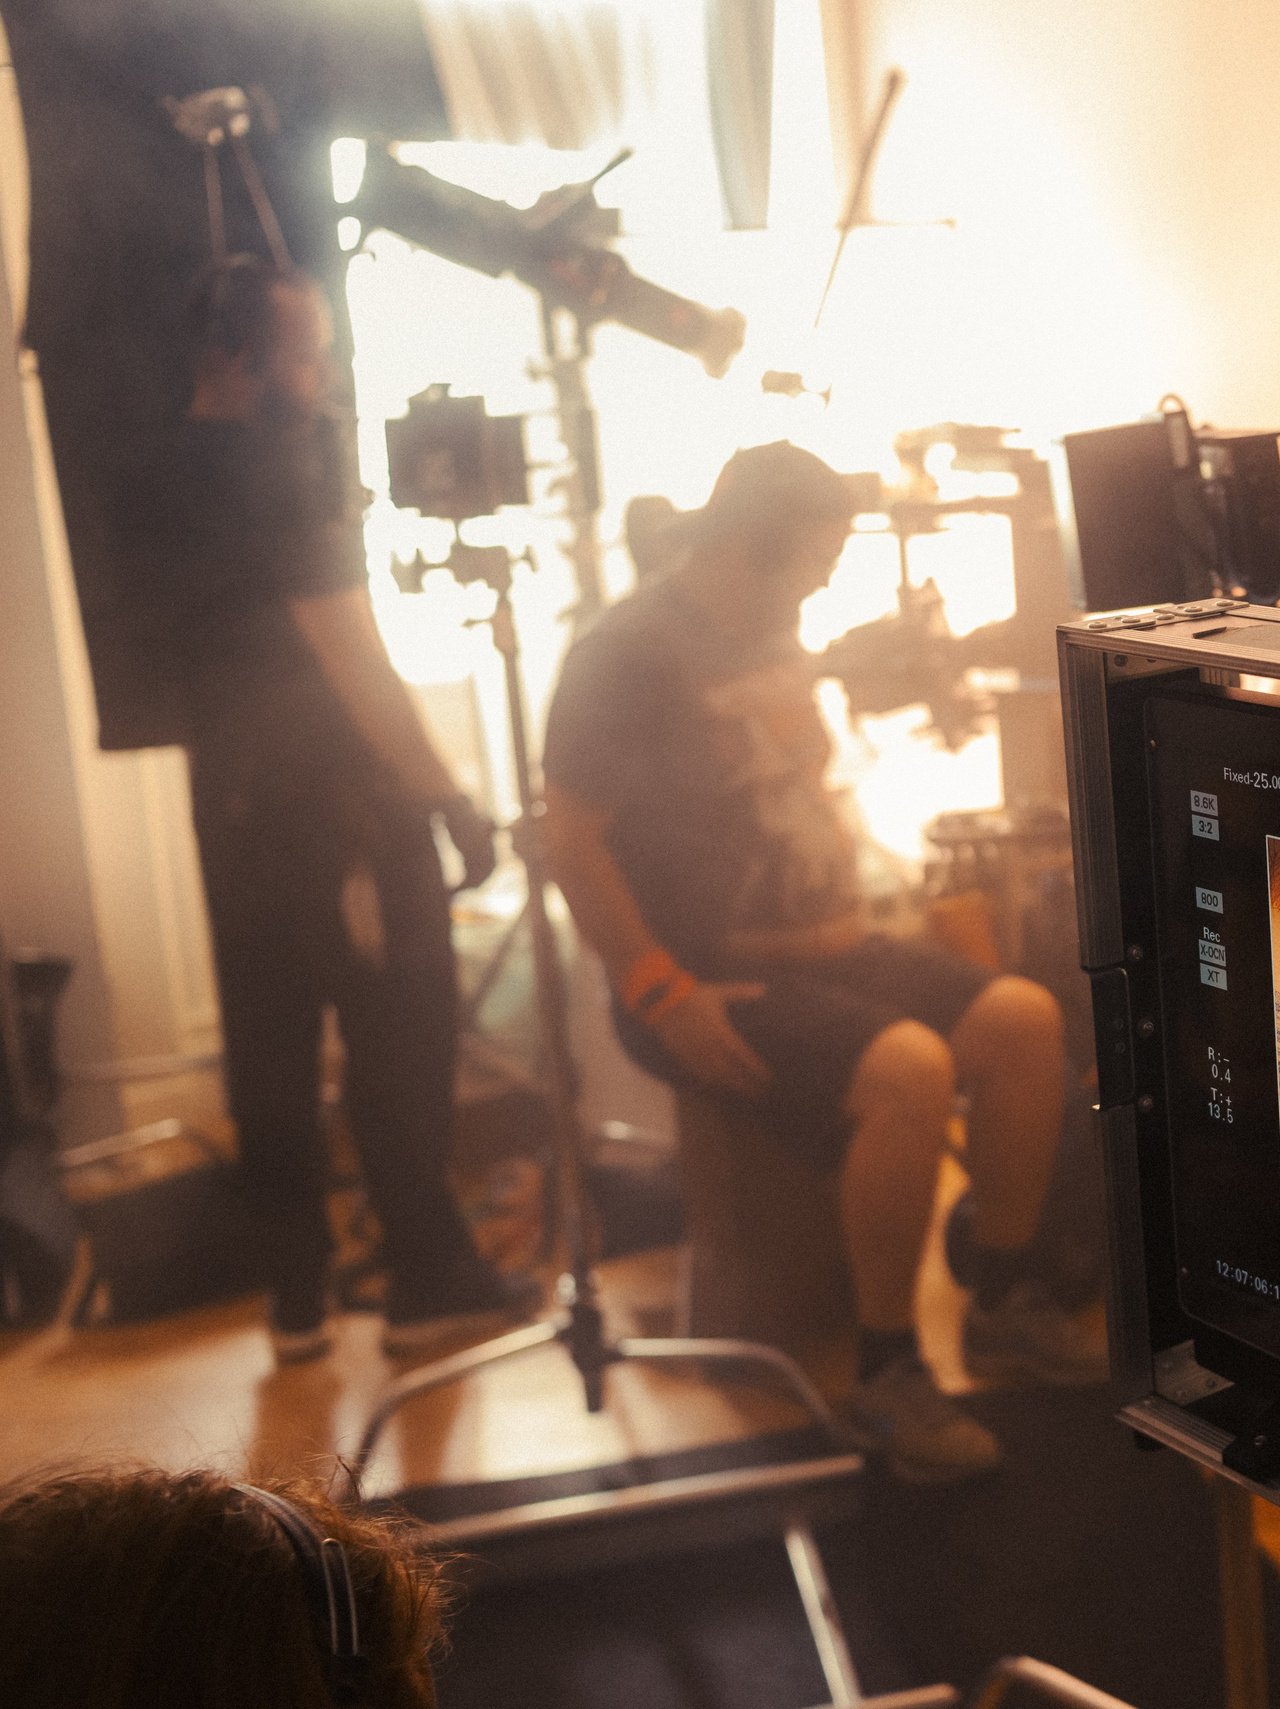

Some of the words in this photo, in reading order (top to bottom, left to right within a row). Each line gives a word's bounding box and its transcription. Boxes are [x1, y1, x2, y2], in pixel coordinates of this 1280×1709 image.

[1194, 794, 1215, 811] 8.6K
[1198, 818, 1213, 834] 3:2
[1200, 892, 1219, 908] 800
[1203, 927, 1221, 942] Rec
[1200, 944, 1225, 962] X-OCN
[1207, 968, 1220, 983] XT
[1211, 1063, 1232, 1083] 0.4
[1208, 1102, 1234, 1124] 13.5
